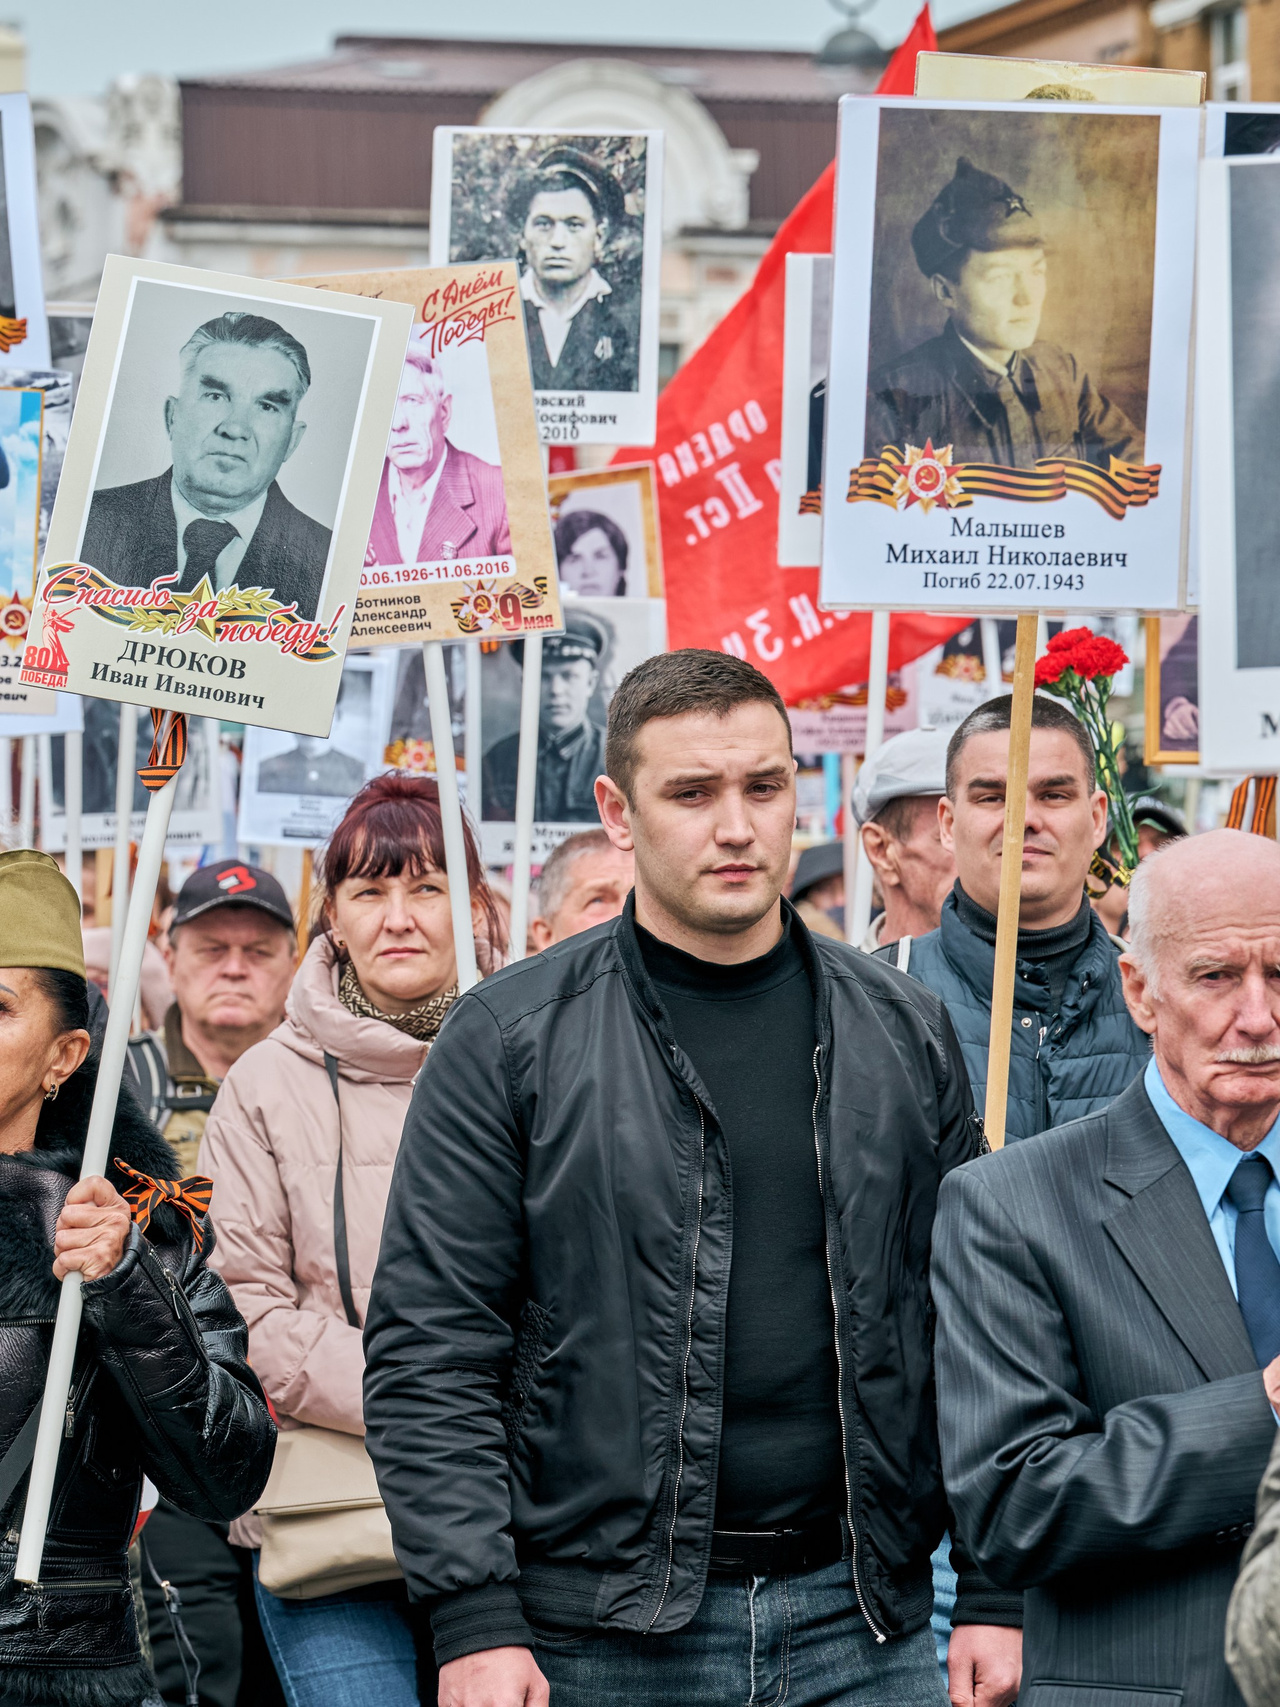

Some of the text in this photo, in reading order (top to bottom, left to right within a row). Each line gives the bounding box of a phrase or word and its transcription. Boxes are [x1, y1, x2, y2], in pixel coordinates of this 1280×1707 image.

[442, 270, 503, 307] Днём
[420, 291, 516, 358] Победы!
[537, 410, 616, 428] осифович
[951, 516, 1065, 538] Малышев
[886, 544, 1128, 569] Михаил Николаевич
[923, 572, 1085, 591] Погиб 22.07.1943
[42, 566, 346, 653] Спасибо за победу!
[356, 594, 421, 609] Ботников
[499, 593, 522, 631] 9
[353, 607, 427, 622] Александр
[351, 622, 431, 637] Алексеевич
[24, 646, 50, 668] 80
[117, 639, 246, 679] ДРЮКОВ
[20, 670, 67, 688] ПОБЕДА!
[90, 662, 265, 709] Иван Иванович
